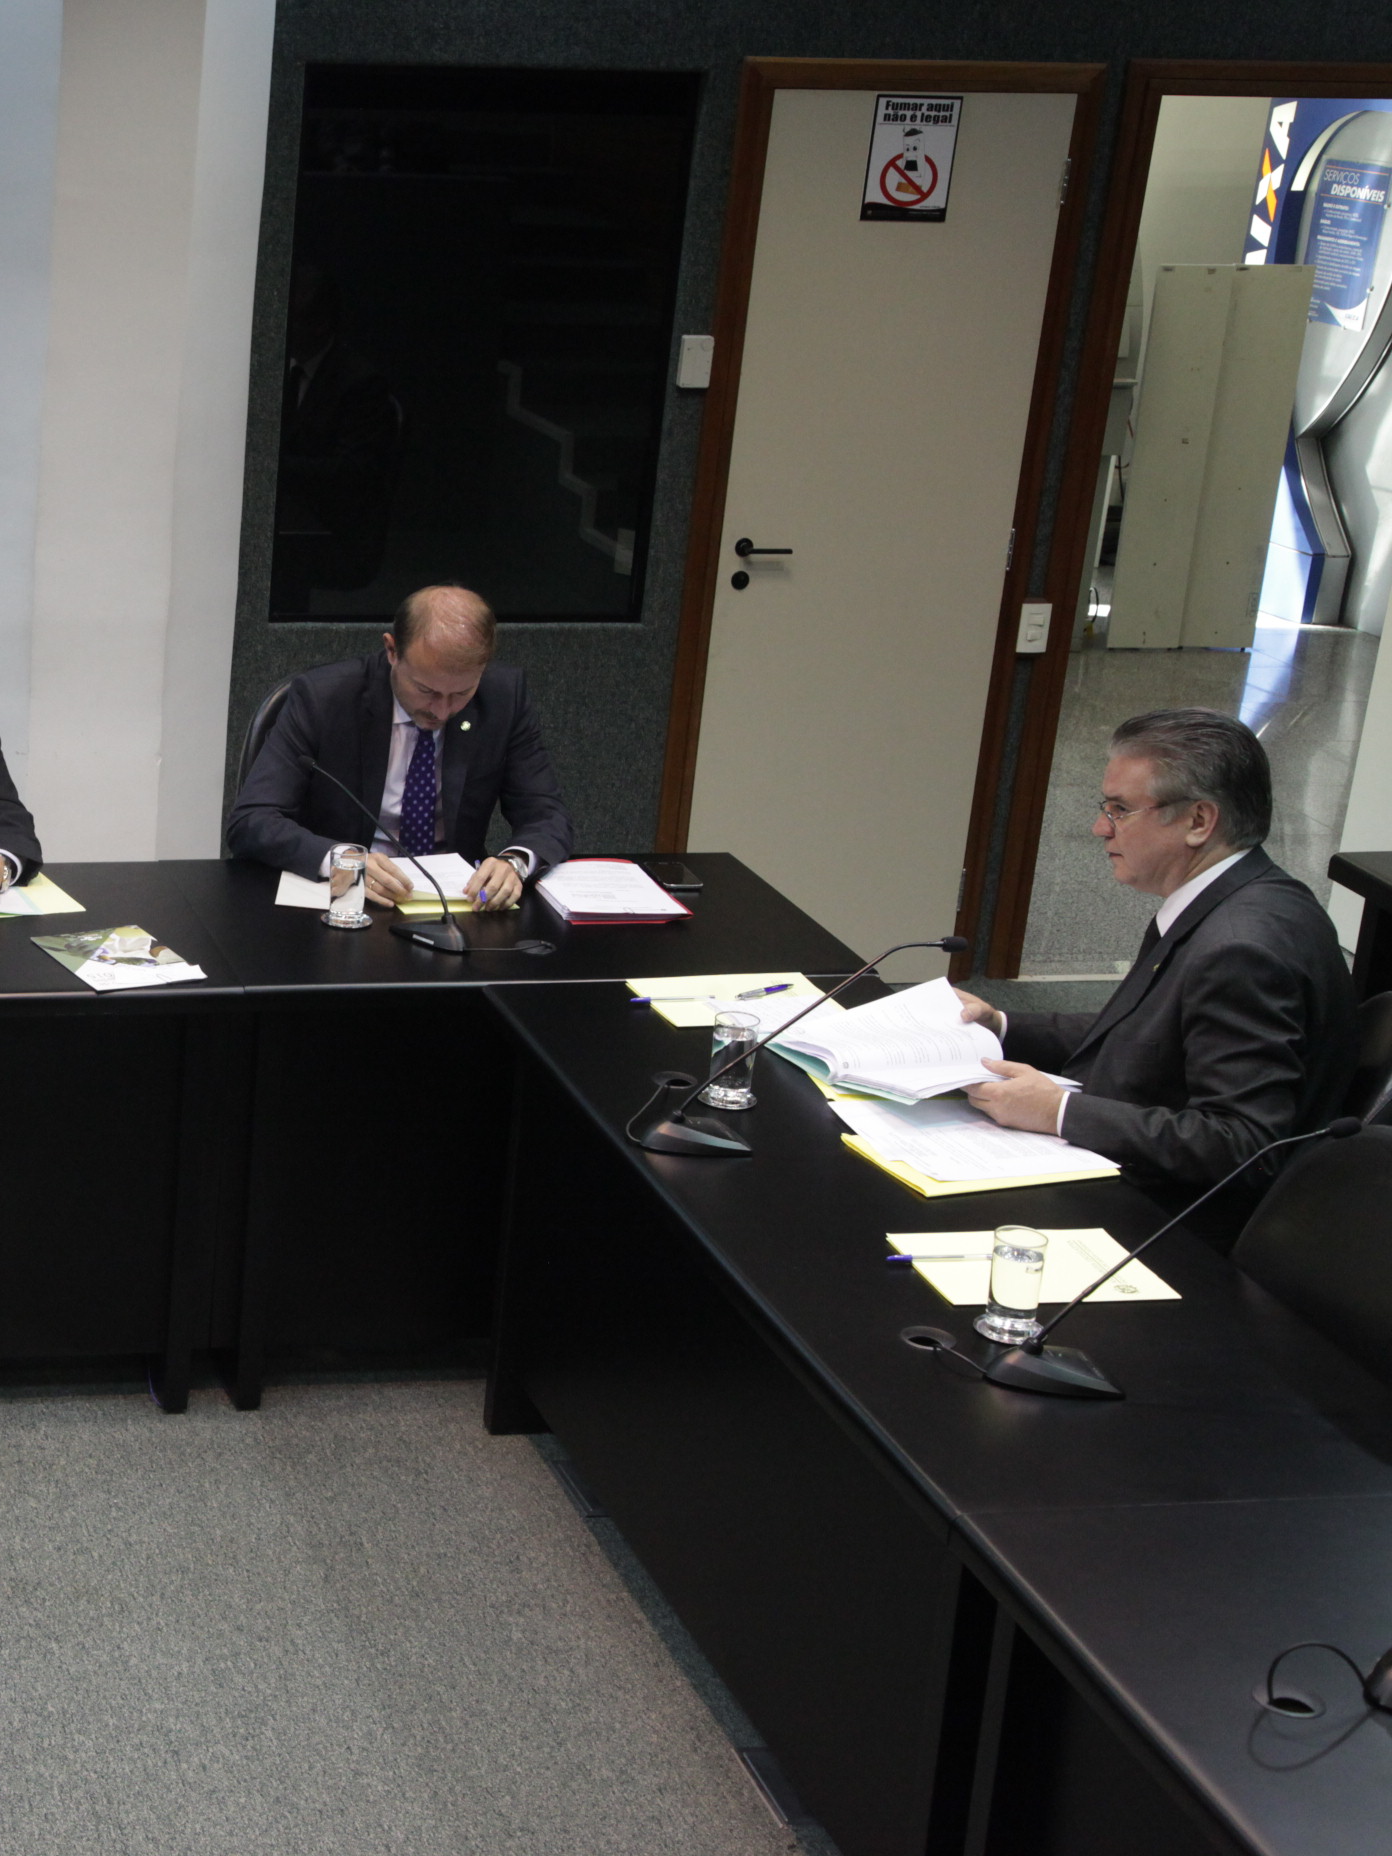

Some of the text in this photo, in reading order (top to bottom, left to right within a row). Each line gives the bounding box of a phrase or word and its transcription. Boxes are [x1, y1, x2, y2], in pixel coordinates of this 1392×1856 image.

[884, 99, 954, 113] Fumar aqui
[883, 111, 953, 124] não é legal
[1323, 168, 1360, 185] SERVIÇOS
[1331, 184, 1386, 202] DISPONÍVEIS
